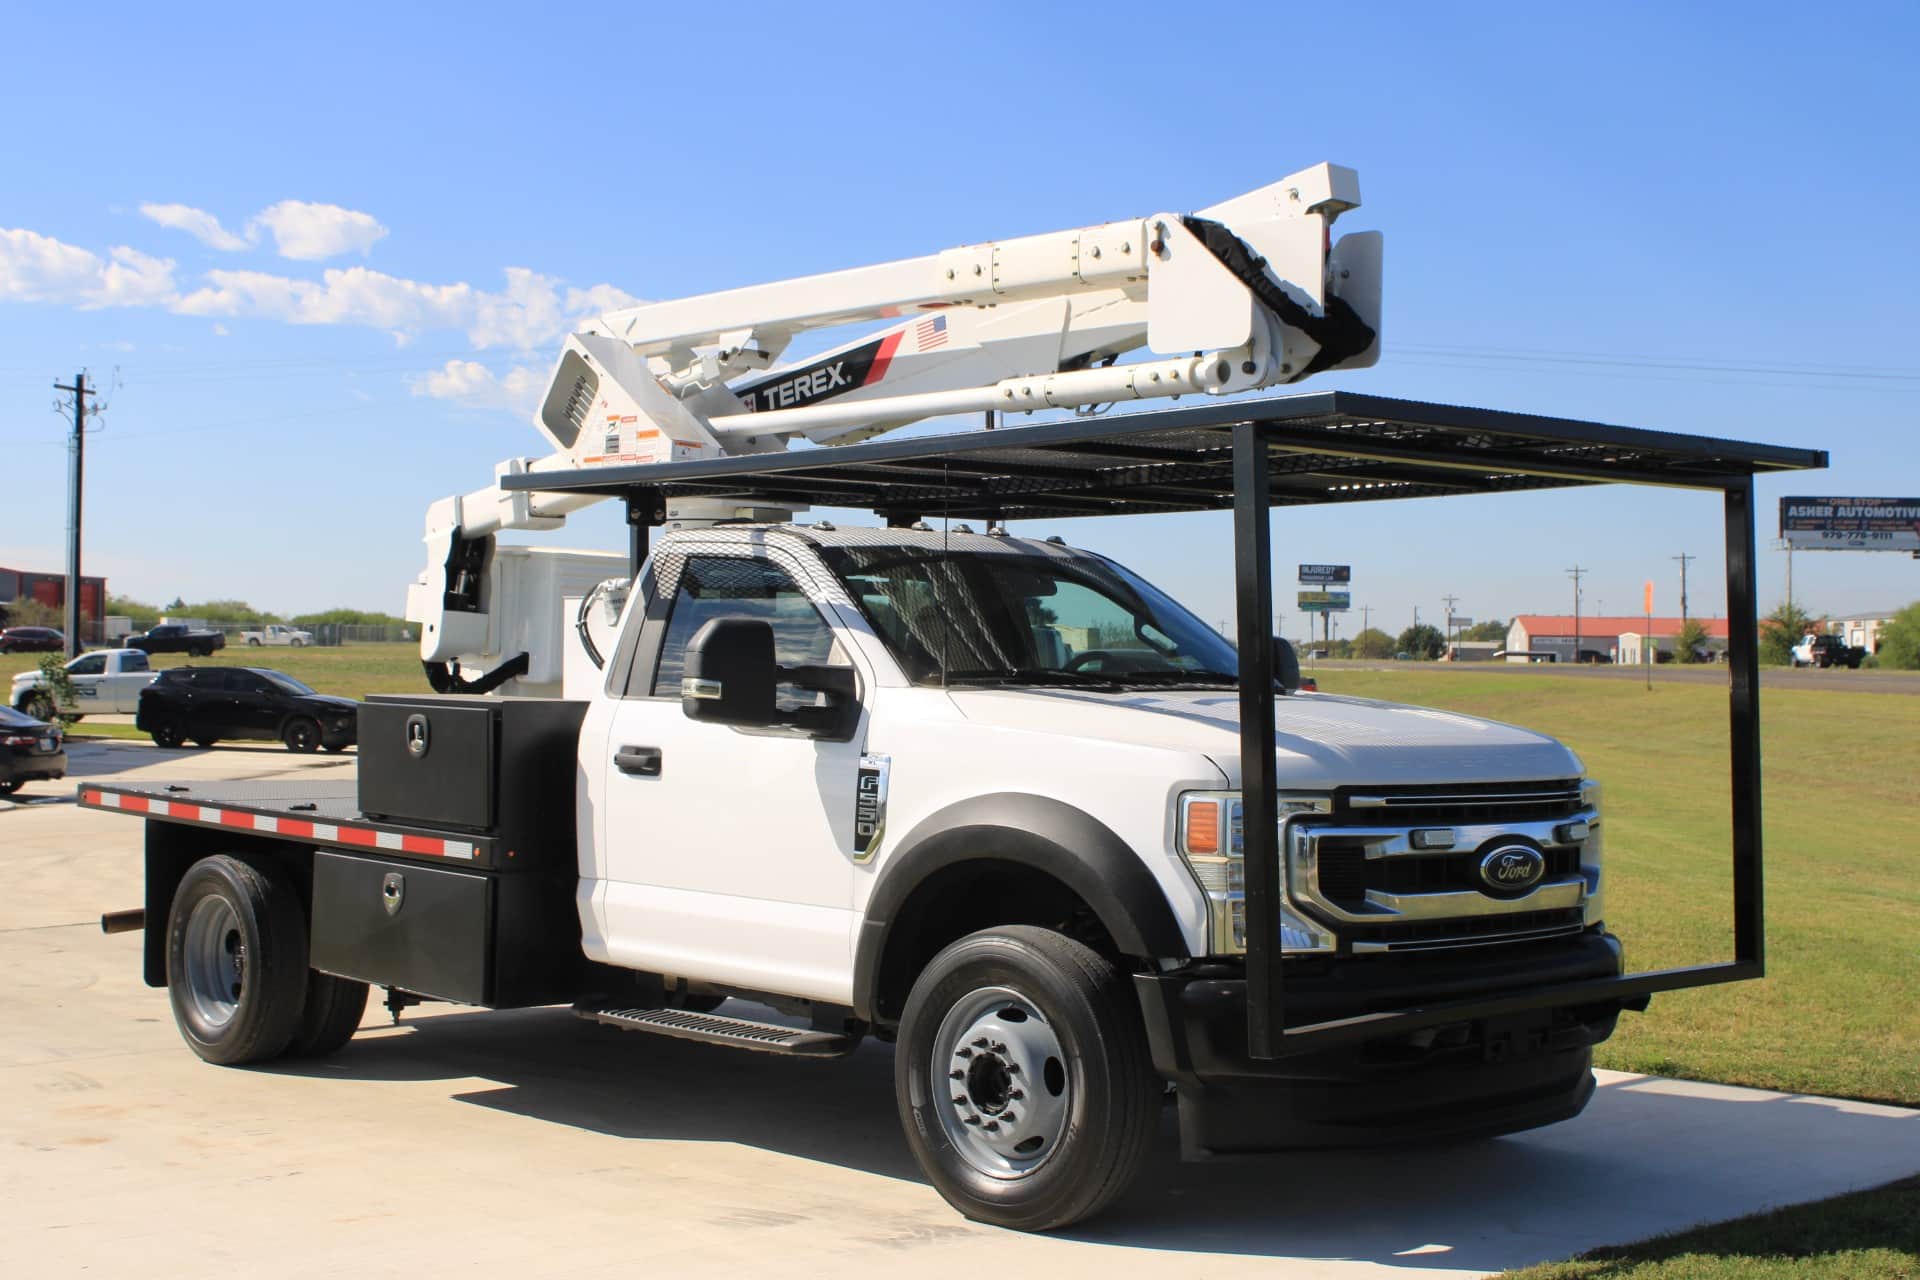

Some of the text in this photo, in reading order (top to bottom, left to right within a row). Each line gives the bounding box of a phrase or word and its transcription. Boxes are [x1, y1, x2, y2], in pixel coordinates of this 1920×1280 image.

[1853, 498, 1882, 506] STOP
[1788, 506, 1833, 517] ASHER
[1498, 855, 1532, 881] Ford
